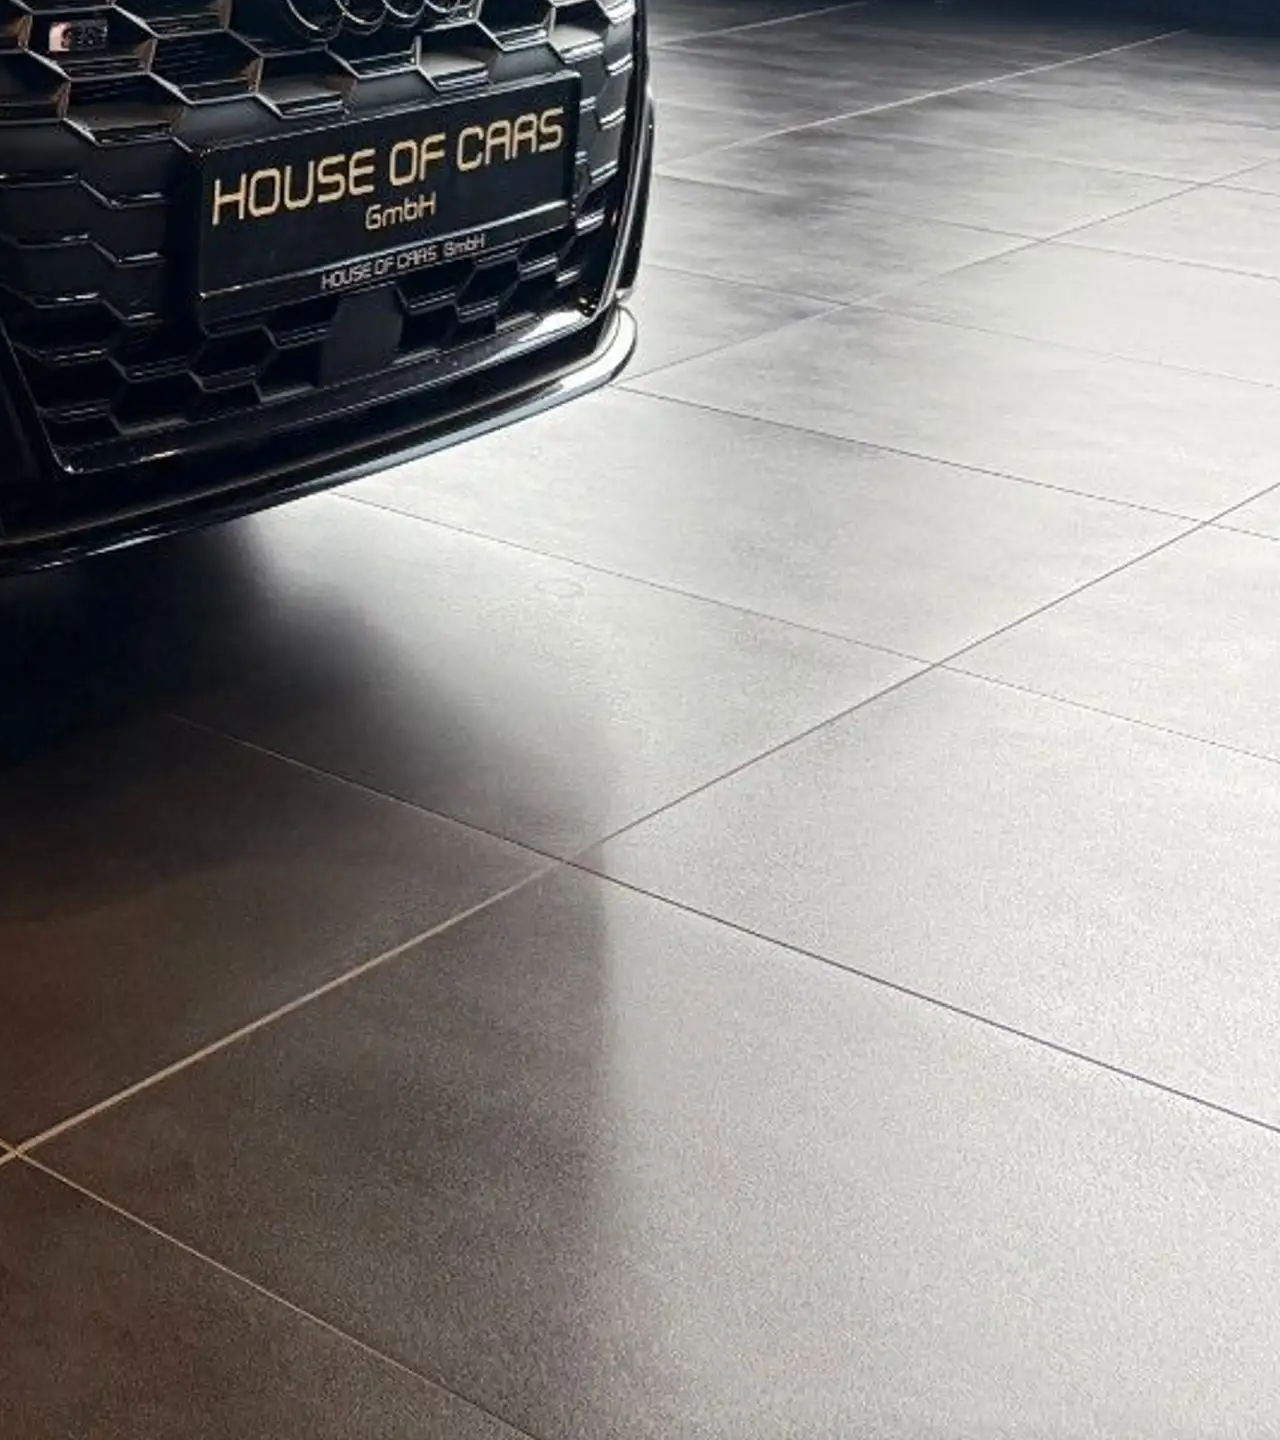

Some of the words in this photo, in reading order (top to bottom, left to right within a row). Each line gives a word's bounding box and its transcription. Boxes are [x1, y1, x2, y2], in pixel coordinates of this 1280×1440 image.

[211, 148, 376, 225] HOUSE
[389, 132, 446, 186] OF
[456, 107, 565, 172] CARS
[365, 192, 438, 231] GmbH
[321, 261, 372, 289] HOUSE
[374, 256, 395, 275] OF
